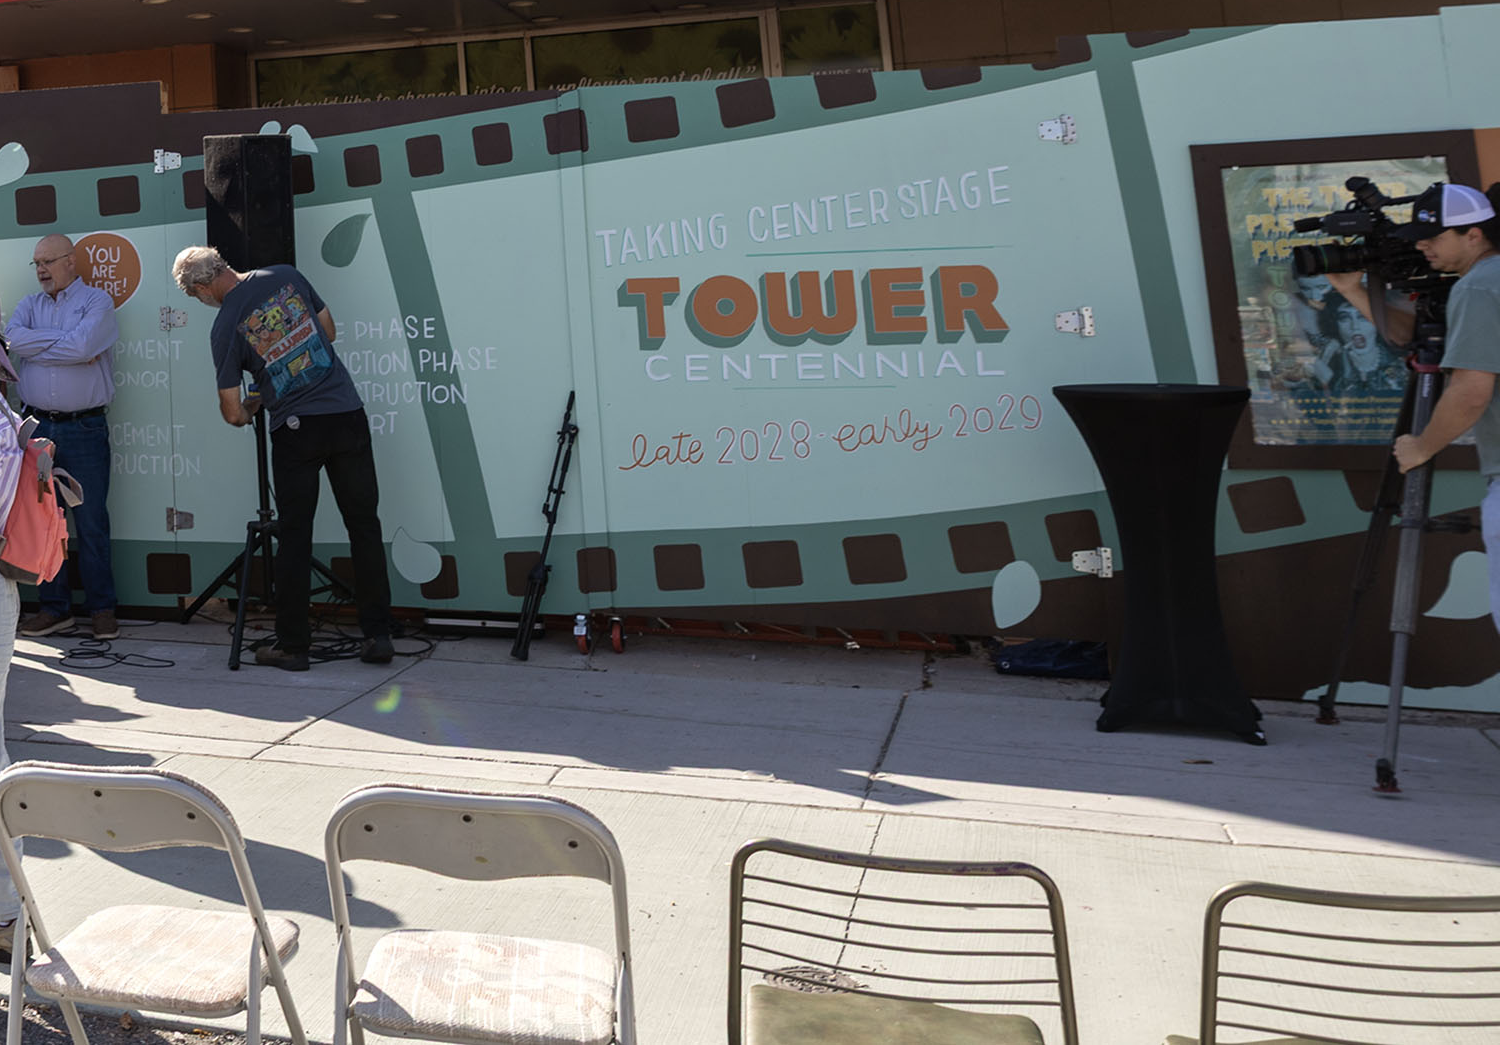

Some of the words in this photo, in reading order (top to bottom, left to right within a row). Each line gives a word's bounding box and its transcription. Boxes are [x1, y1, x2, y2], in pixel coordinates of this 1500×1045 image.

[1261, 186, 1313, 211] THE
[85, 244, 121, 264] YOU
[595, 213, 729, 267] TAKING
[91, 265, 117, 280] ARE
[617, 263, 1011, 351] TOWER
[354, 314, 437, 342] PHASE
[418, 346, 499, 375] PHASE
[644, 349, 1007, 383] CENTENNIAL
[114, 370, 170, 389] ONOR
[618, 431, 705, 471] late
[831, 408, 944, 452] early
[948, 393, 1044, 438] 2029
